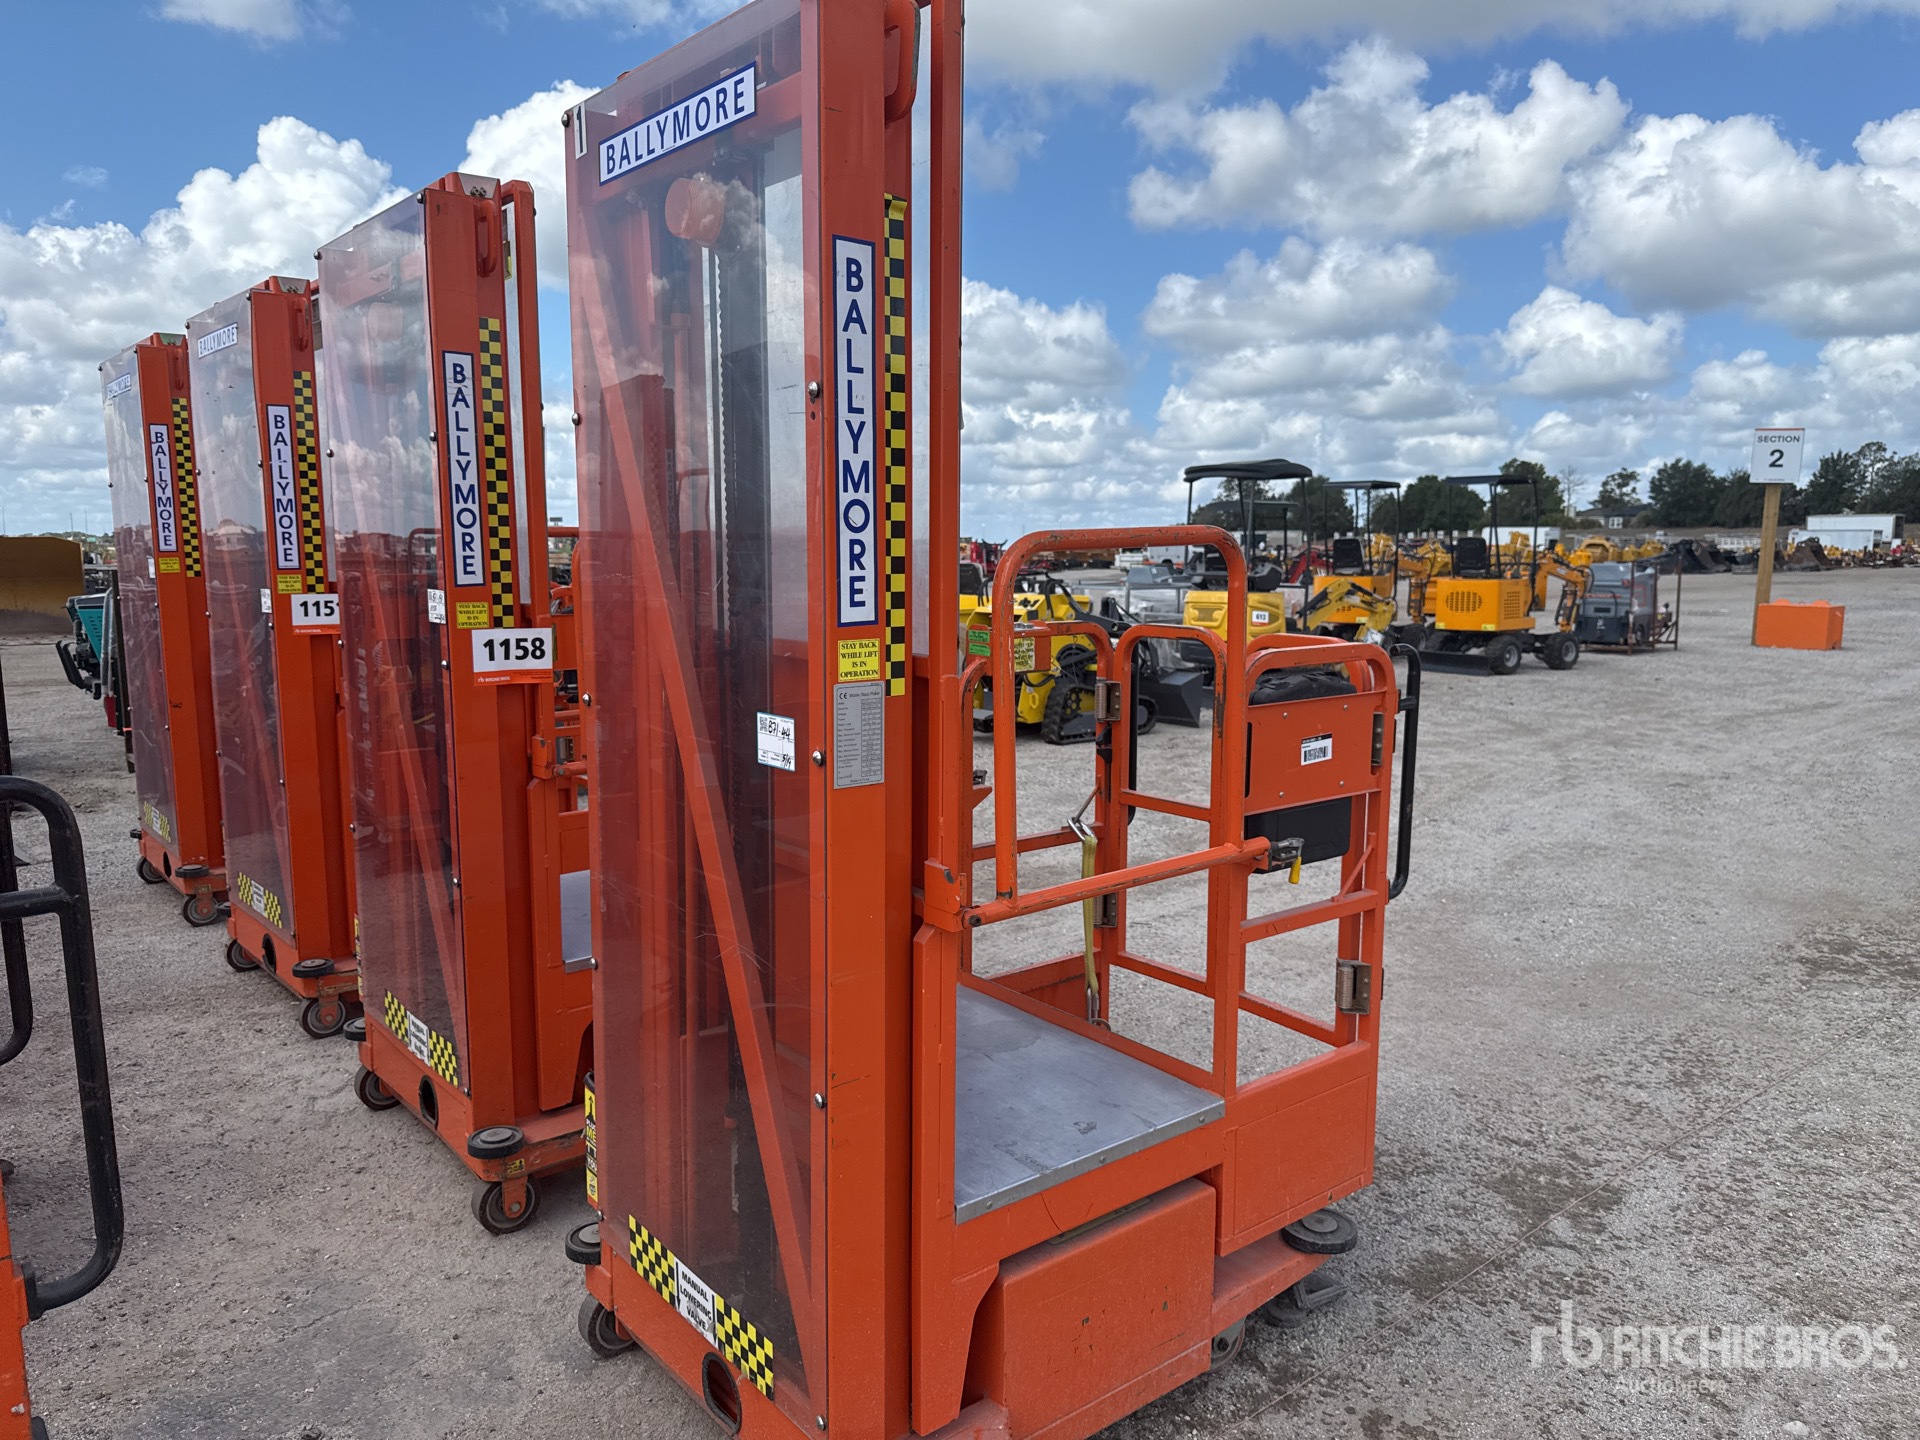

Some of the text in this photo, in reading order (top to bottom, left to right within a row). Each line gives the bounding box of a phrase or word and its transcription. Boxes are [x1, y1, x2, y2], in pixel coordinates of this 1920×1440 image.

[605, 76, 746, 176] BALLYMORE
[842, 256, 870, 608] BALLYMORE
[1757, 435, 1800, 443] SECTION
[452, 362, 477, 576] BALLYMORE
[1768, 449, 1784, 468] 2
[154, 431, 172, 547] BALLYMORE
[273, 414, 294, 562] BALLYMORE
[299, 600, 340, 617] 115
[483, 637, 546, 661] 1158
[840, 650, 878, 659] WHILE LIFT
[841, 641, 877, 650] STAY BACK
[840, 669, 878, 678] OPERATION
[681, 1270, 709, 1303] MANUAL
[680, 1284, 712, 1321] LOWERING
